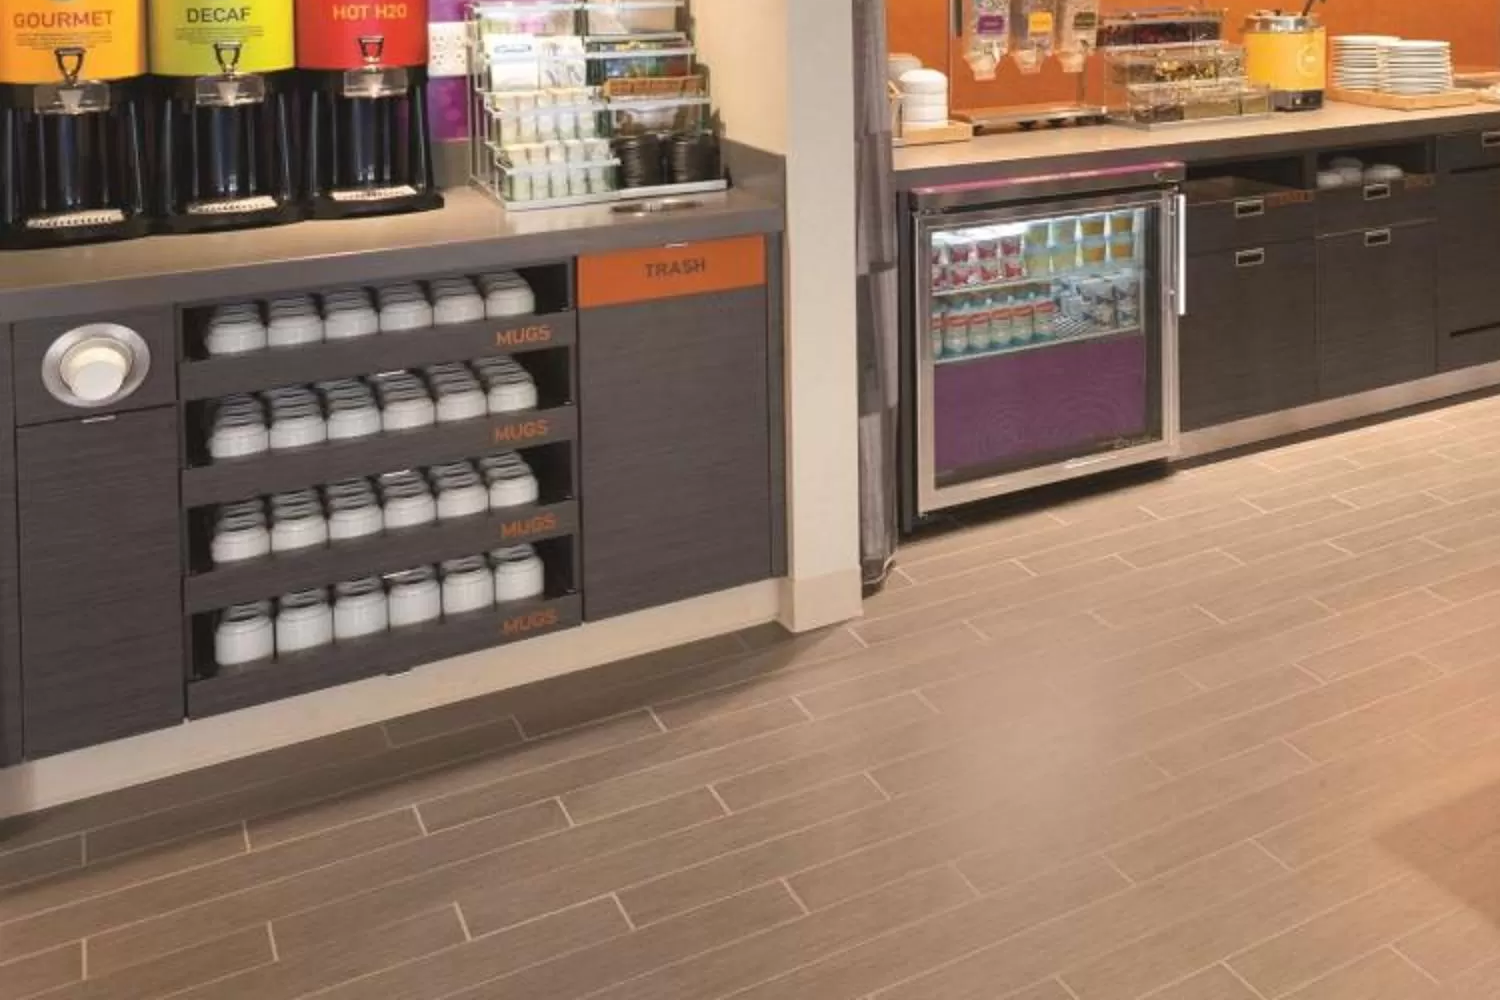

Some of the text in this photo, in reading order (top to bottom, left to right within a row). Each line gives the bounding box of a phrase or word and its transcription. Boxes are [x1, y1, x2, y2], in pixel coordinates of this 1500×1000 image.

[13, 10, 114, 30] GOURMET
[187, 7, 252, 23] DECAF
[332, 4, 370, 21] HOT
[645, 259, 706, 278] TRASH
[495, 325, 552, 347] MUGS
[495, 419, 550, 442] MUGS
[501, 513, 558, 538] MUGS
[502, 609, 558, 635] MUGS
